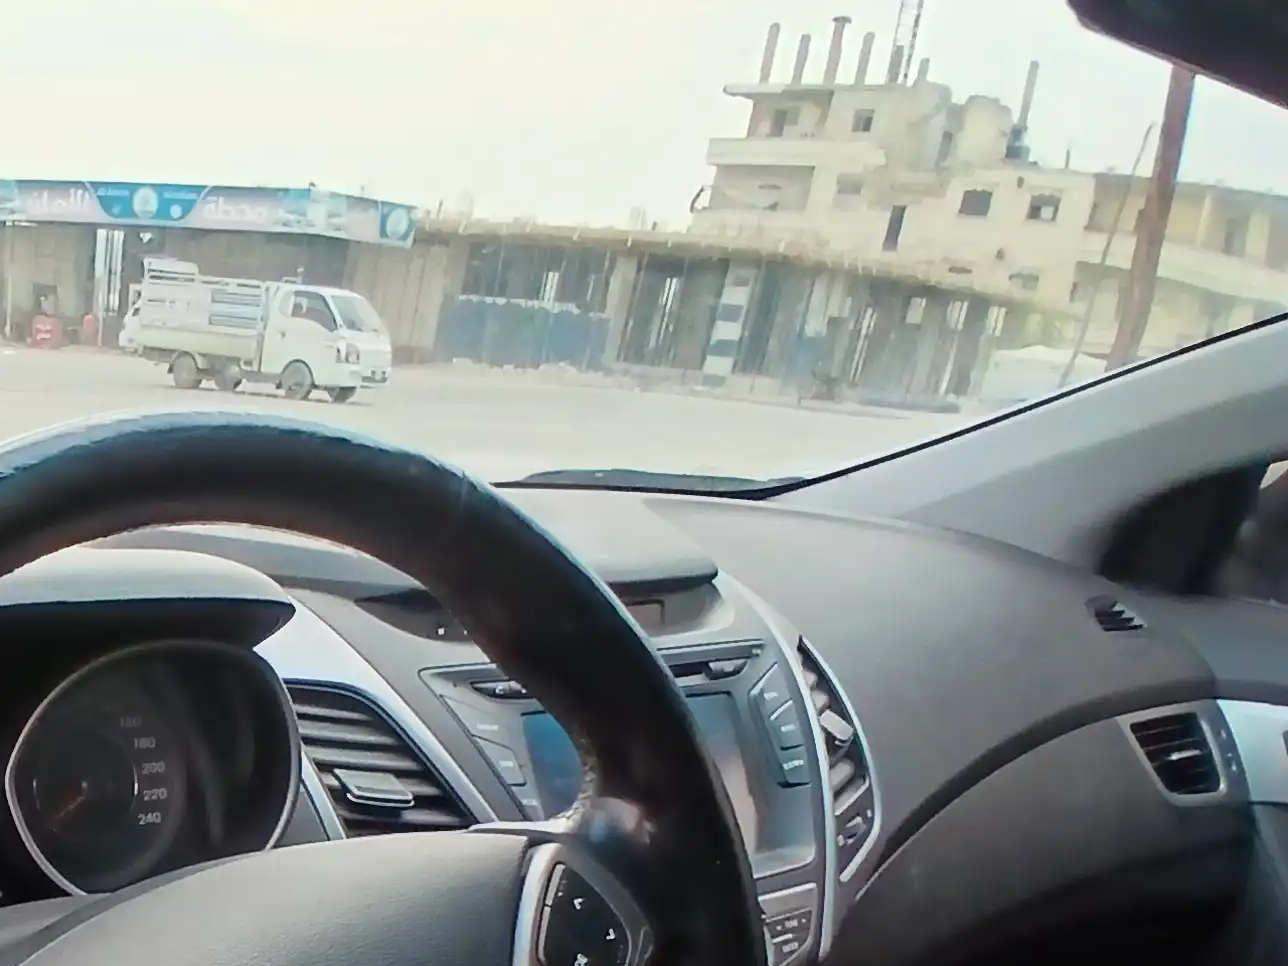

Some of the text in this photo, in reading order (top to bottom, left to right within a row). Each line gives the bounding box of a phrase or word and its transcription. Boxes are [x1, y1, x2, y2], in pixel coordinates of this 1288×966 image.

[133, 736, 156, 749] 180
[141, 761, 166, 775] 200
[143, 787, 167, 801] 220
[137, 811, 162, 825] 240
